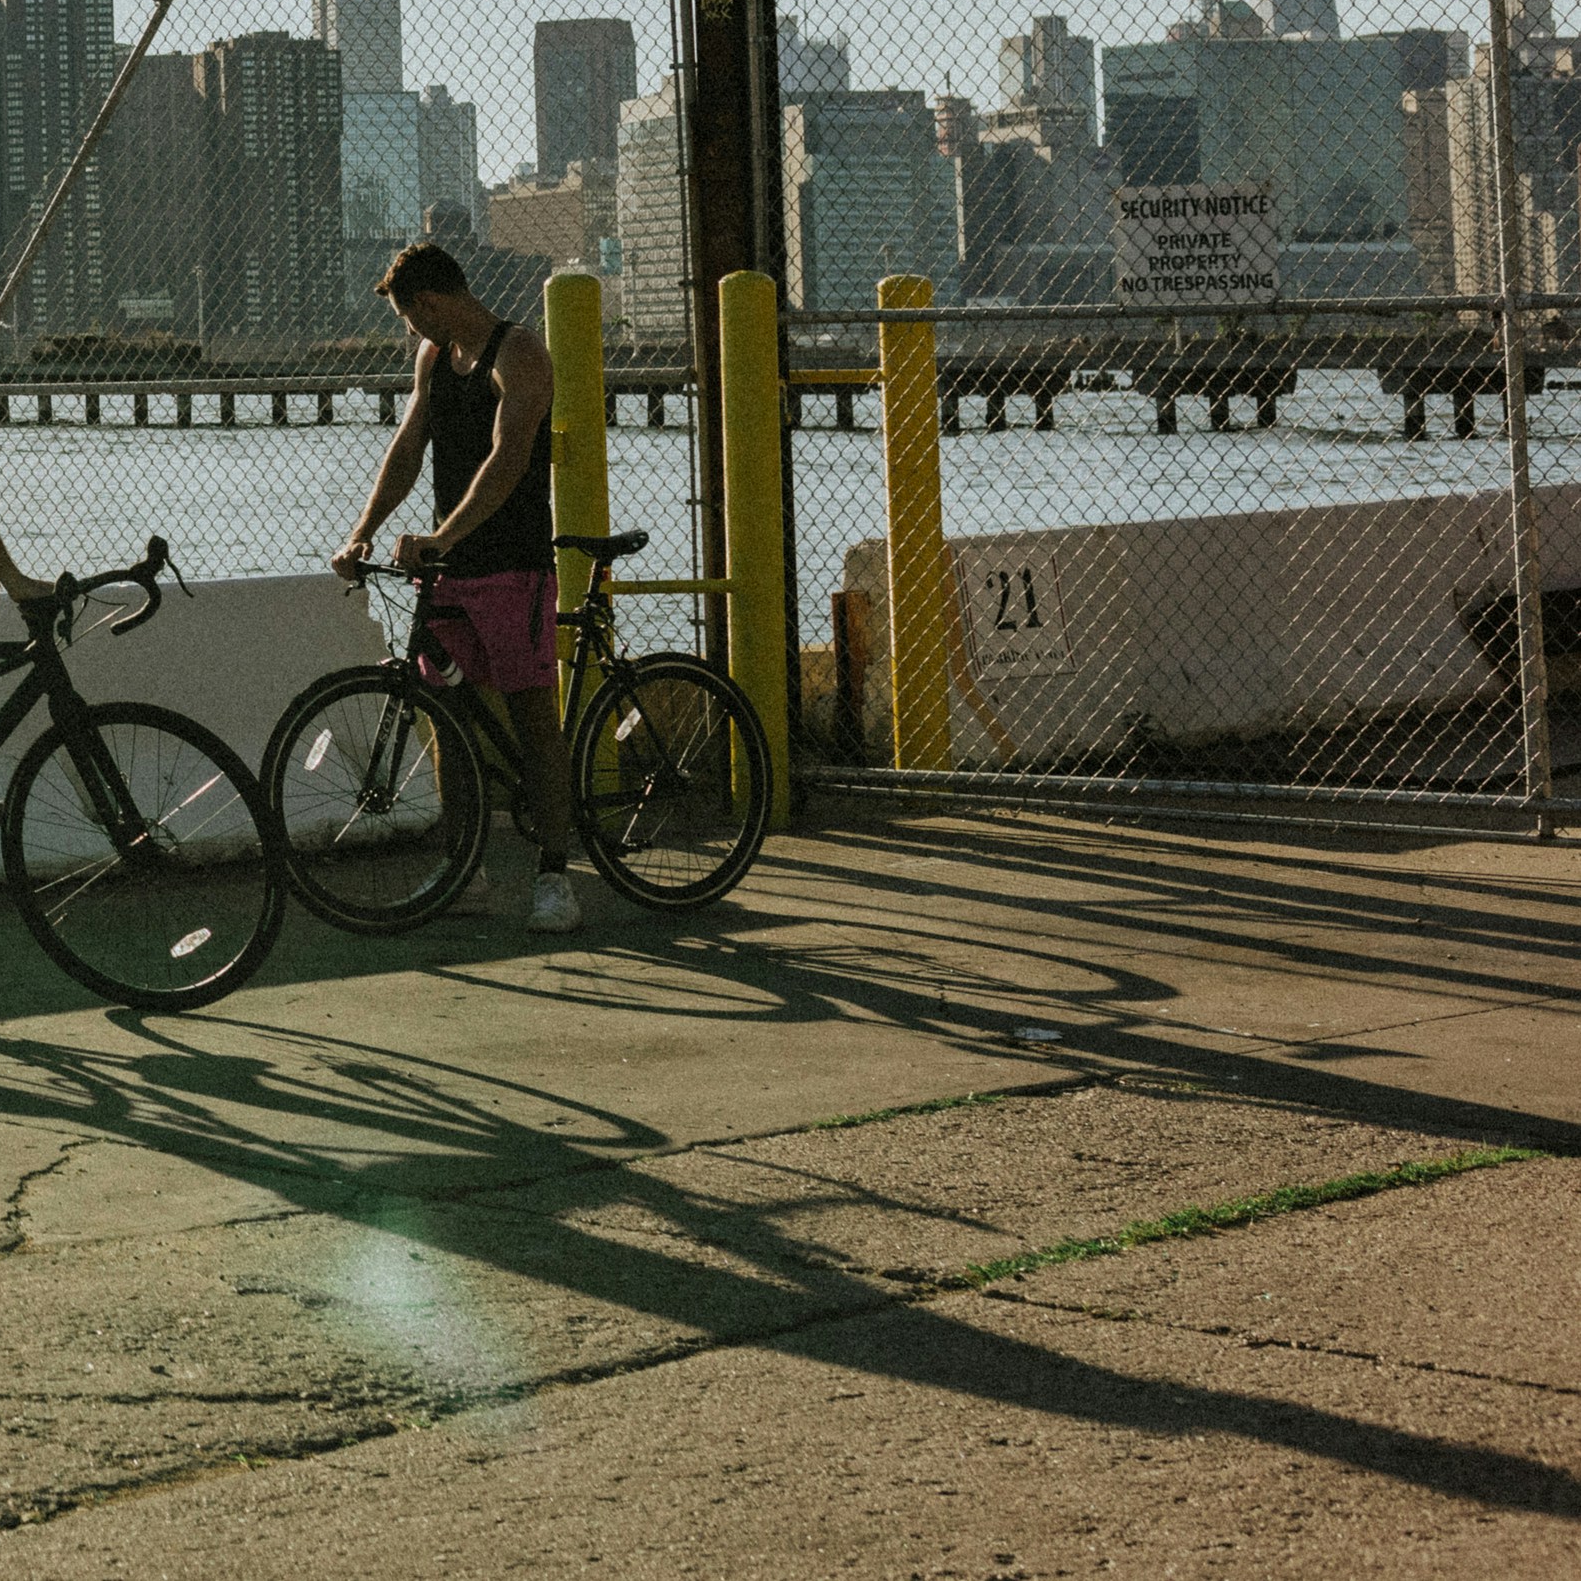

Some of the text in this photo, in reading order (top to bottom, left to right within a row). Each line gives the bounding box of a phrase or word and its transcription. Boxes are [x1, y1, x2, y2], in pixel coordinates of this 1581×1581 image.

[1120, 195, 1269, 219] SECURITY NOTICE
[1157, 233, 1232, 250] PRIVATE
[1148, 254, 1242, 271] PROPERTY
[1122, 273, 1274, 293] NO TRESPASSING
[985, 568, 1043, 632] 21
